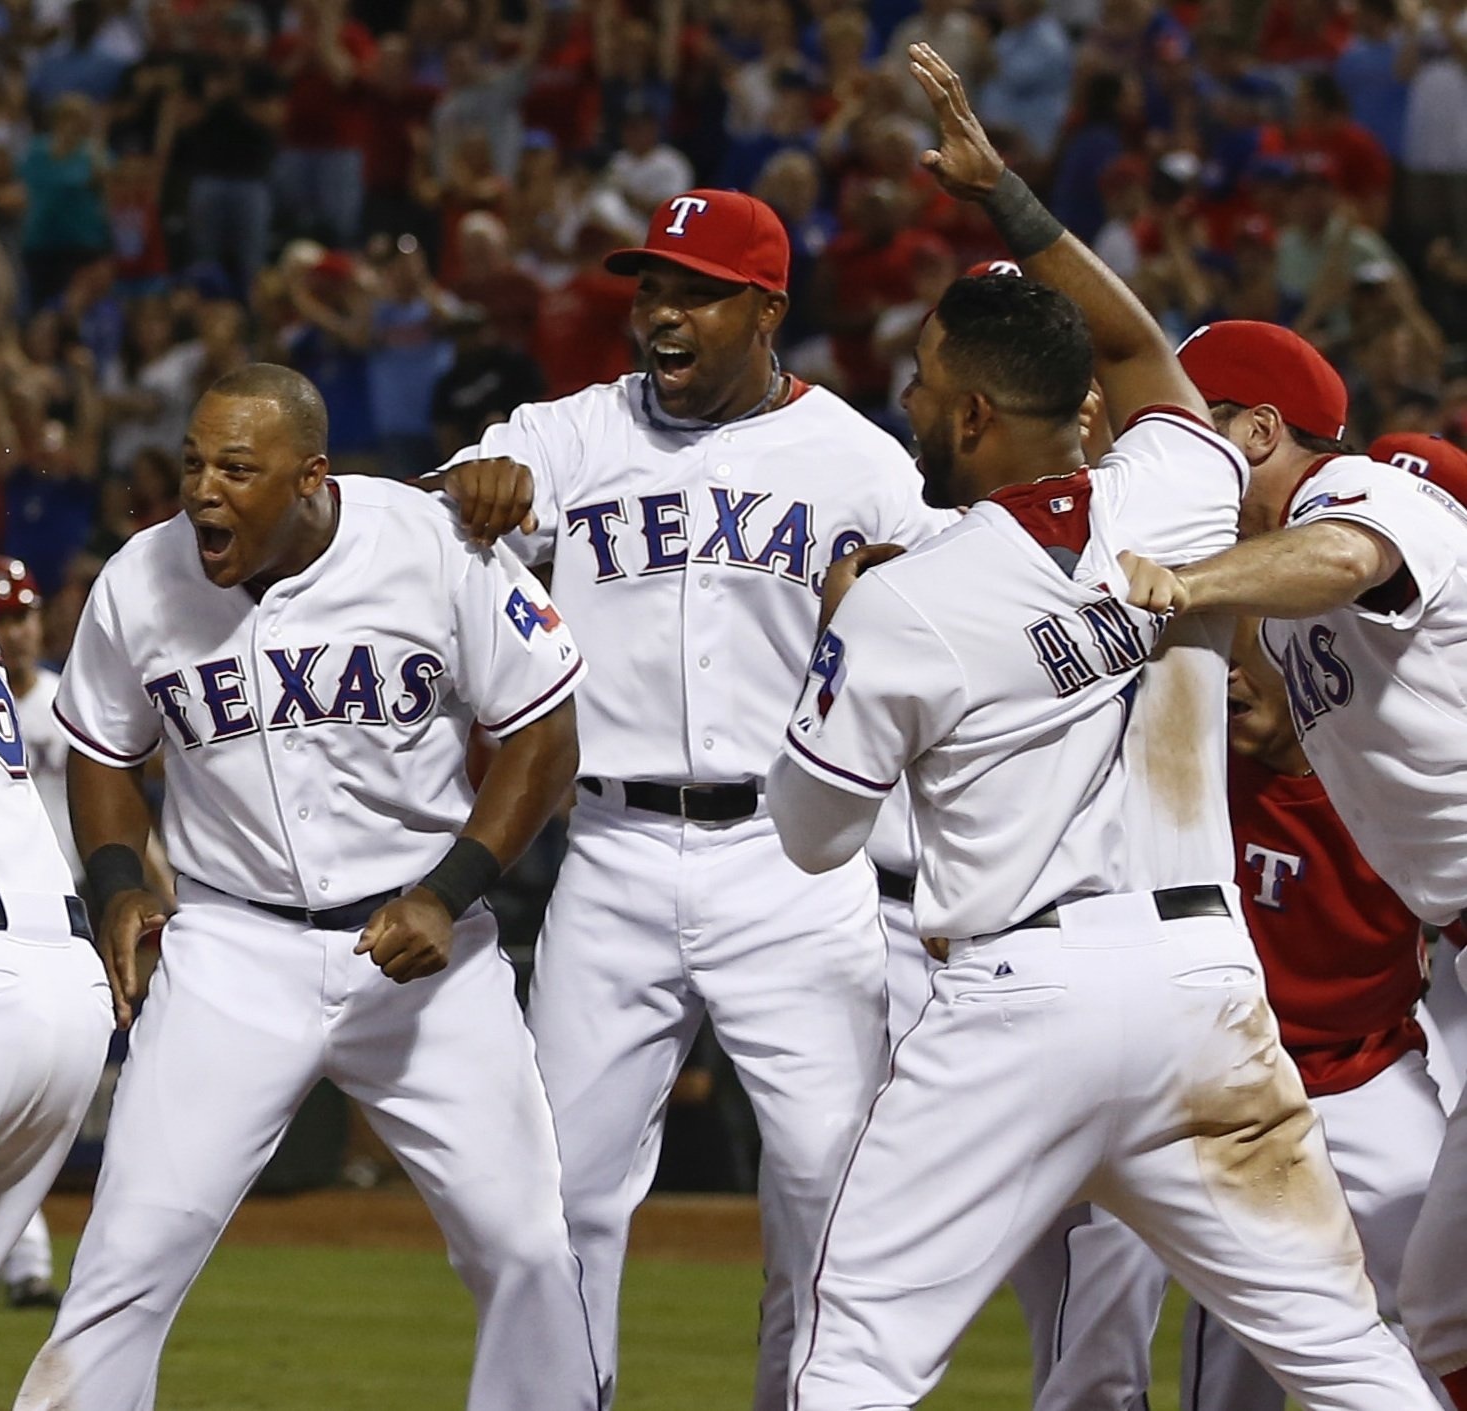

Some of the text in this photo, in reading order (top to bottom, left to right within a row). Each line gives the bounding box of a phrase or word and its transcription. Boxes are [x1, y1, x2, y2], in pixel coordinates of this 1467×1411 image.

[665, 196, 709, 238] T
[143, 643, 447, 751] TEXAS
[1244, 842, 1305, 911] T
